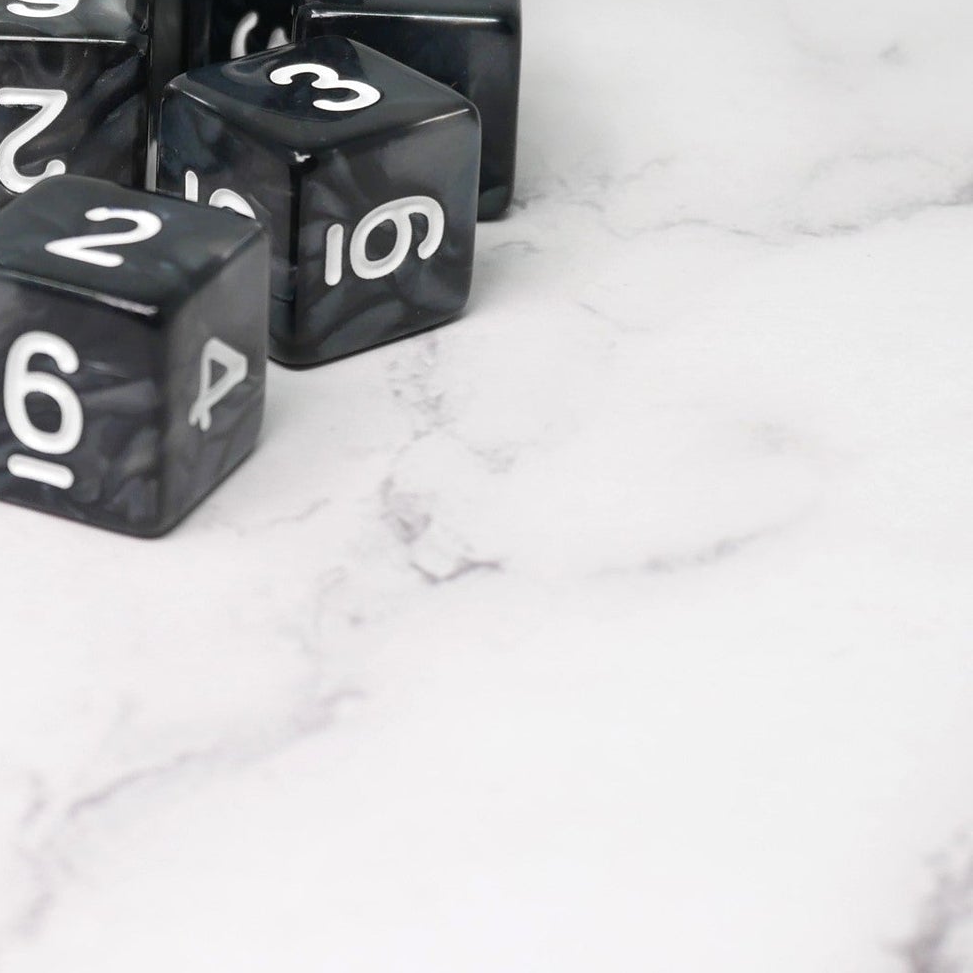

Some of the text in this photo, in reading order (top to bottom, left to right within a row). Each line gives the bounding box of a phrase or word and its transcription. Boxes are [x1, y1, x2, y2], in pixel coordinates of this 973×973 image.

[269, 62, 381, 112] 3
[44, 207, 163, 268] 2
[324, 195, 446, 286] 6
[3, 330, 84, 489] 6
[188, 337, 249, 431] 4
